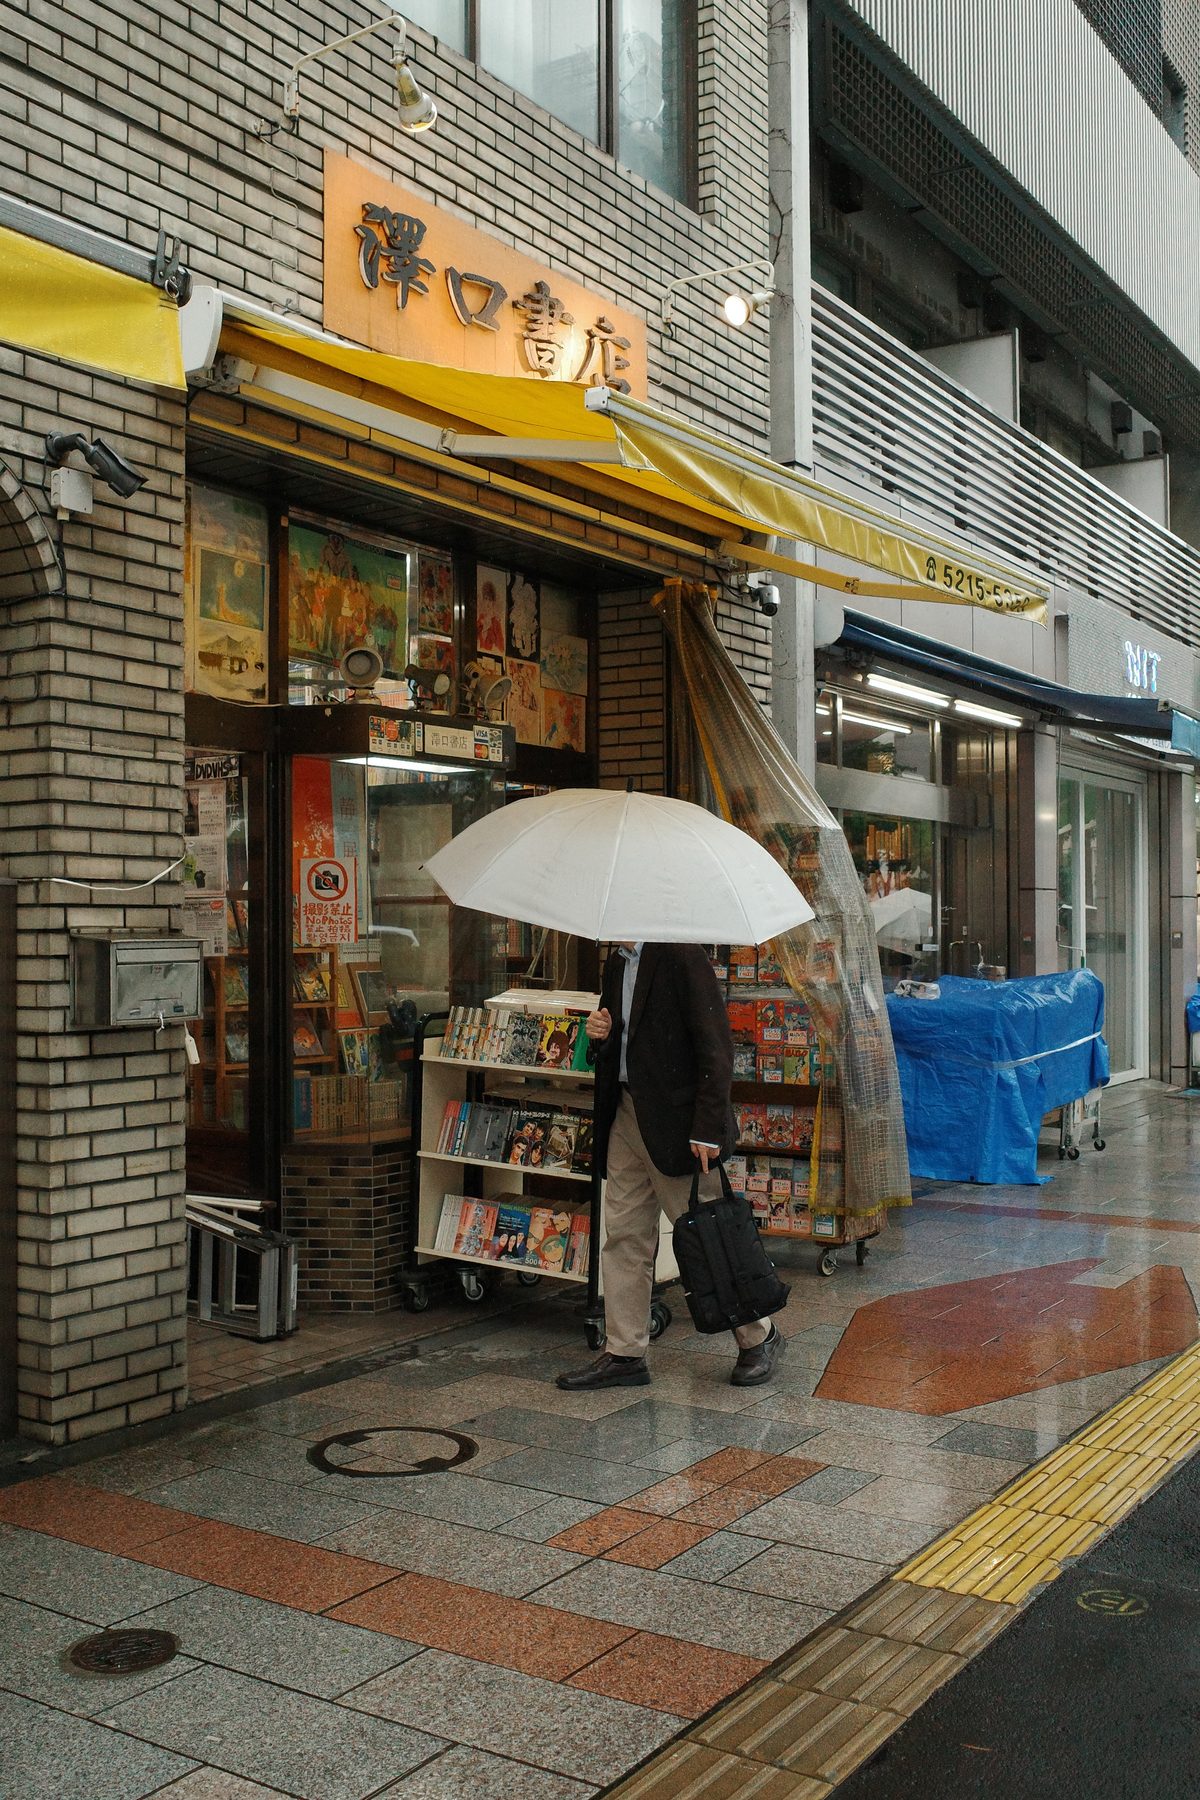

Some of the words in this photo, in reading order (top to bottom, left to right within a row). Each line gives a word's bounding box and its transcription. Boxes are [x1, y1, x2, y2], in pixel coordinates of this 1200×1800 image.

[354, 200, 632, 396] 澤口書店
[475, 729, 488, 738] VISA
[302, 902, 353, 916] 撮影禁止
